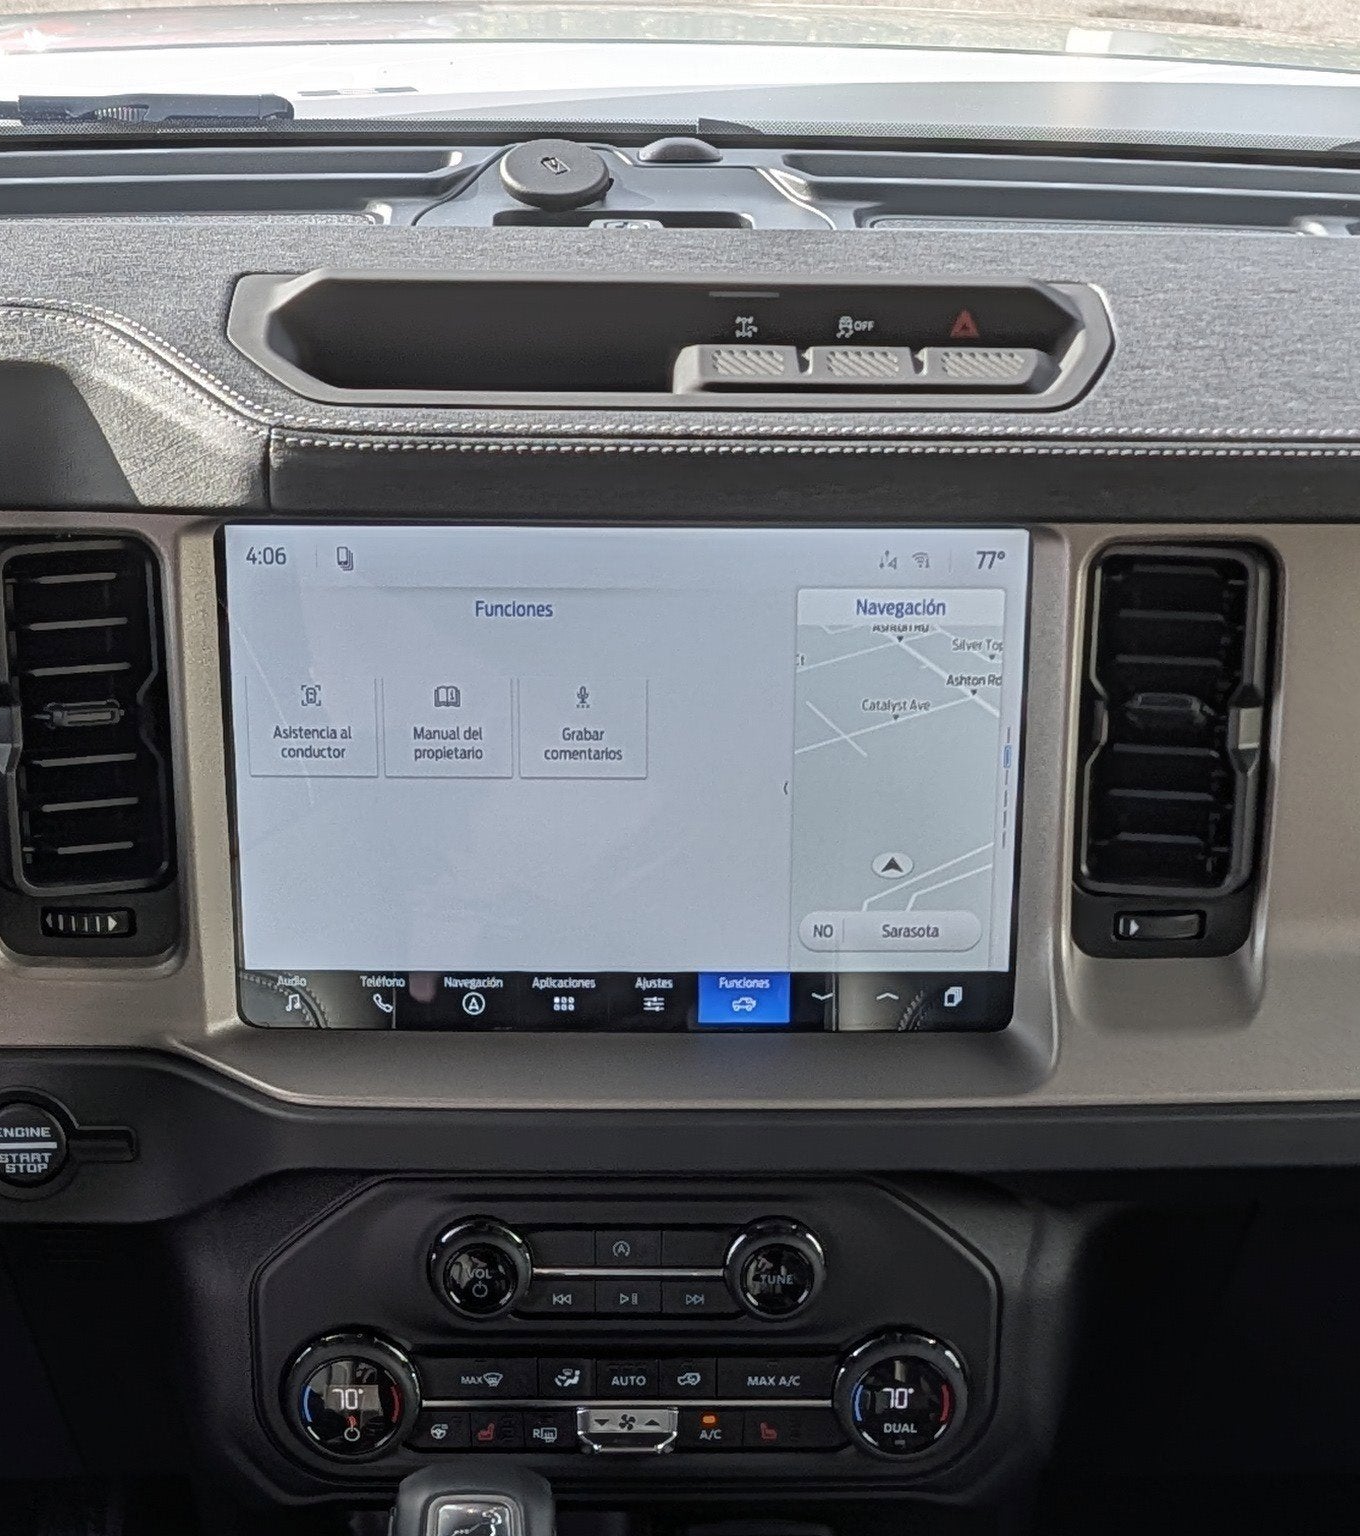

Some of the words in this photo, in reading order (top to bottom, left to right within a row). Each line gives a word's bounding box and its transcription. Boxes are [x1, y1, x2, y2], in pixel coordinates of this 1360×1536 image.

[246, 547, 287, 565] 4:06
[475, 600, 554, 617] Funciones
[856, 599, 946, 618] Navegación
[945, 674, 986, 687] Ashton
[861, 699, 907, 712] Catalyst
[909, 699, 931, 711] Ave
[273, 725, 337, 741] Asistencia
[339, 725, 352, 740] al
[413, 726, 460, 741] Manual
[463, 726, 483, 741] del
[562, 726, 605, 741] Grabar
[280, 745, 346, 760] conductor
[413, 746, 483, 762] propietario
[544, 747, 623, 761] comentarios
[813, 924, 834, 938] NO
[881, 924, 940, 938] Sarasota
[277, 975, 307, 987] Audio
[360, 975, 406, 988] Teléfono
[444, 976, 504, 988] Navegación
[532, 976, 596, 989] Aplicaciones
[635, 977, 674, 989] Ajustes
[718, 977, 770, 989] Funciones
[5, 1162, 48, 1174] STOP
[467, 1268, 492, 1280] VOL
[760, 1274, 794, 1285] TUNE
[461, 1375, 483, 1385] MAX
[611, 1375, 647, 1386] AUTO
[747, 1376, 775, 1387] MAX
[778, 1375, 801, 1387] A/C
[699, 1429, 723, 1440] A/C
[883, 1422, 918, 1434] DUAL
